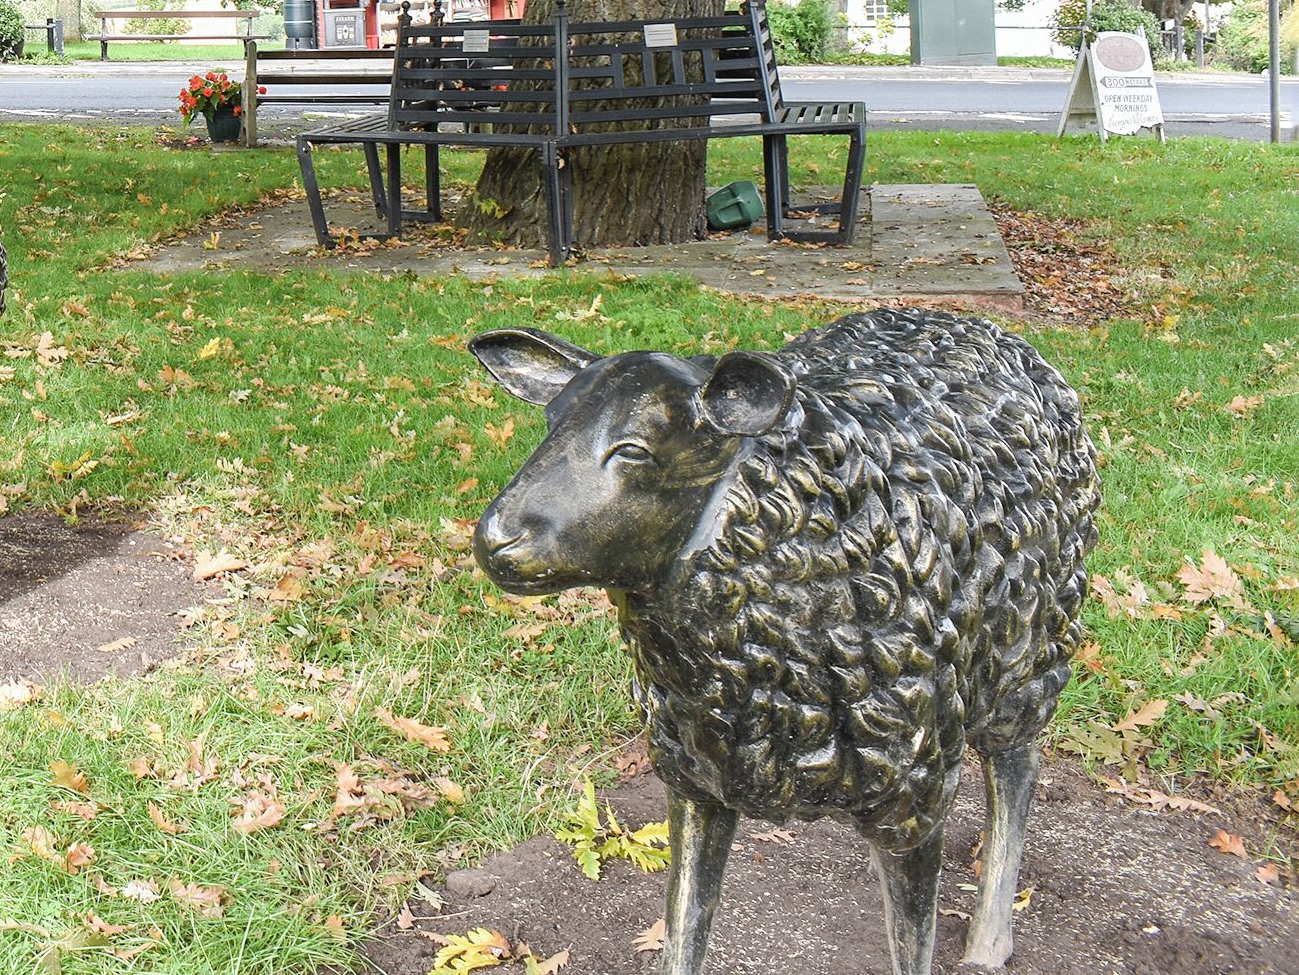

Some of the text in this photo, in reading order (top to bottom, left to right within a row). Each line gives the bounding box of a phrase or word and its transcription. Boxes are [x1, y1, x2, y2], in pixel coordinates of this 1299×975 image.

[1107, 78, 1125, 87] 300
[1104, 94, 1153, 103] OPEN WEEKDAY
[1114, 104, 1148, 113] MORNINGS
